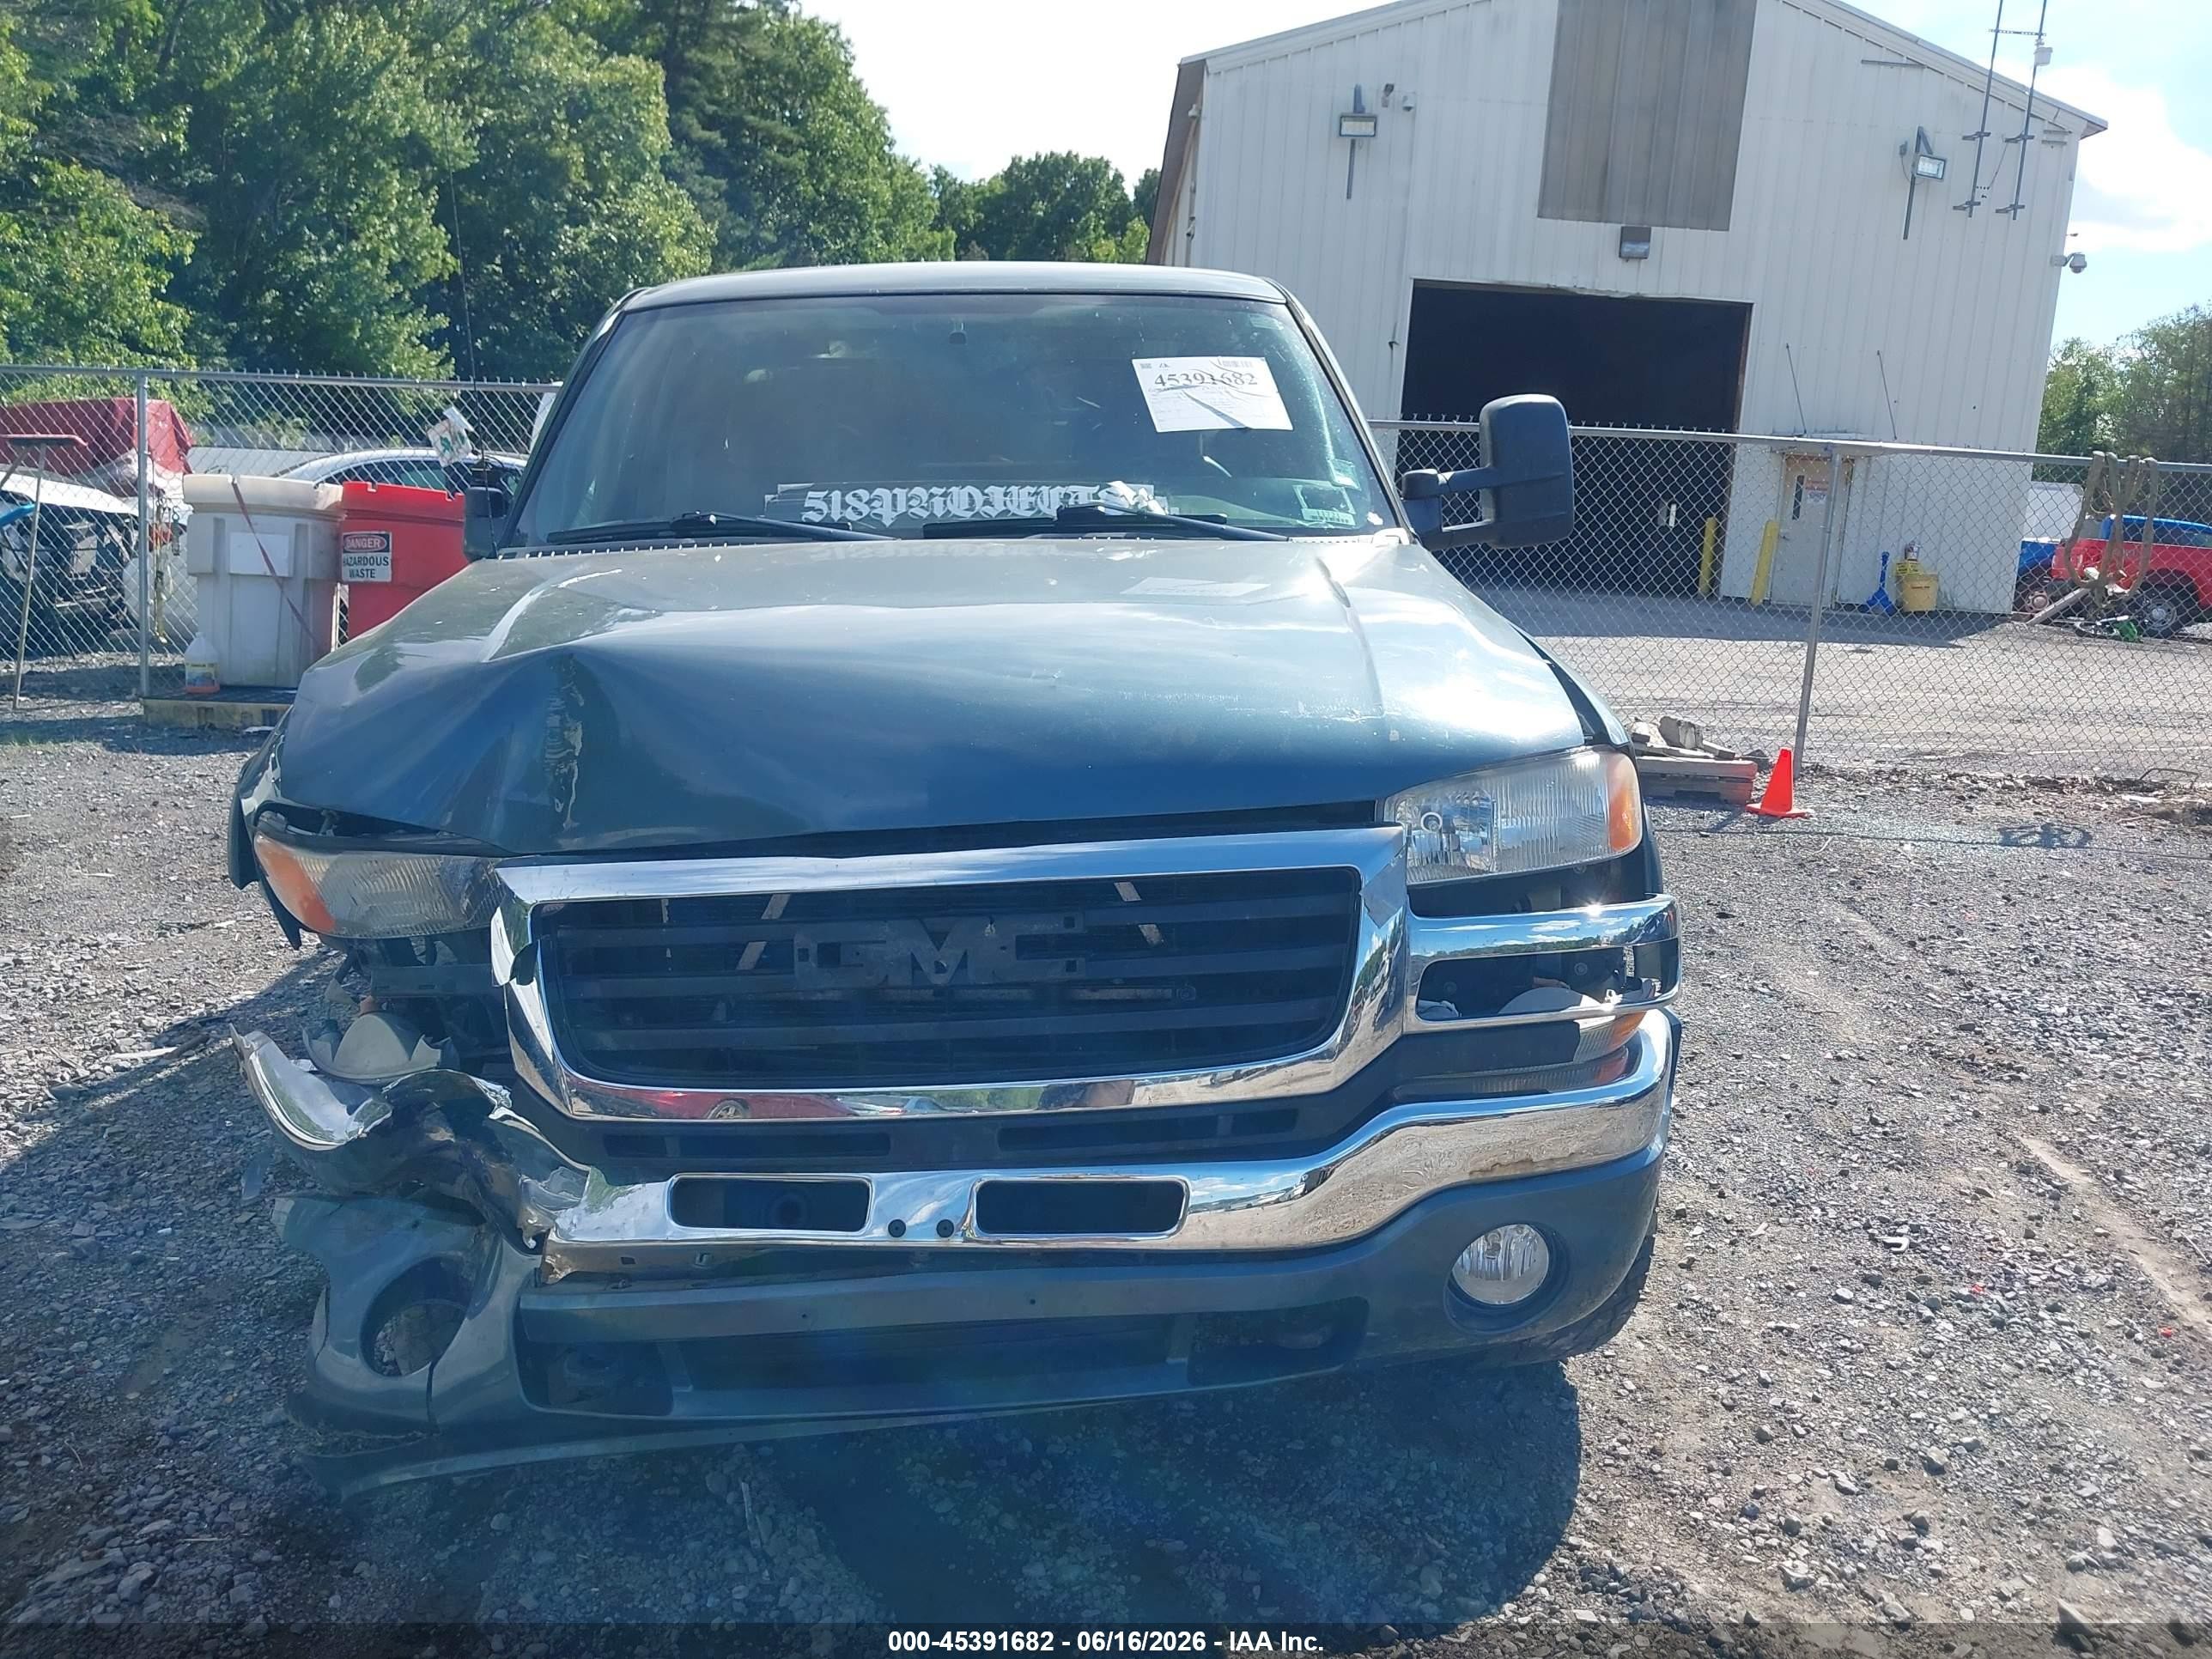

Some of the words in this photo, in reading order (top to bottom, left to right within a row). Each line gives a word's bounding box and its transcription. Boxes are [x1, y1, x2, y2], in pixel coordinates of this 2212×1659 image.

[346, 538, 380, 549] DANGER
[349, 568, 376, 579] WASTE
[793, 914, 1085, 988] GMC
